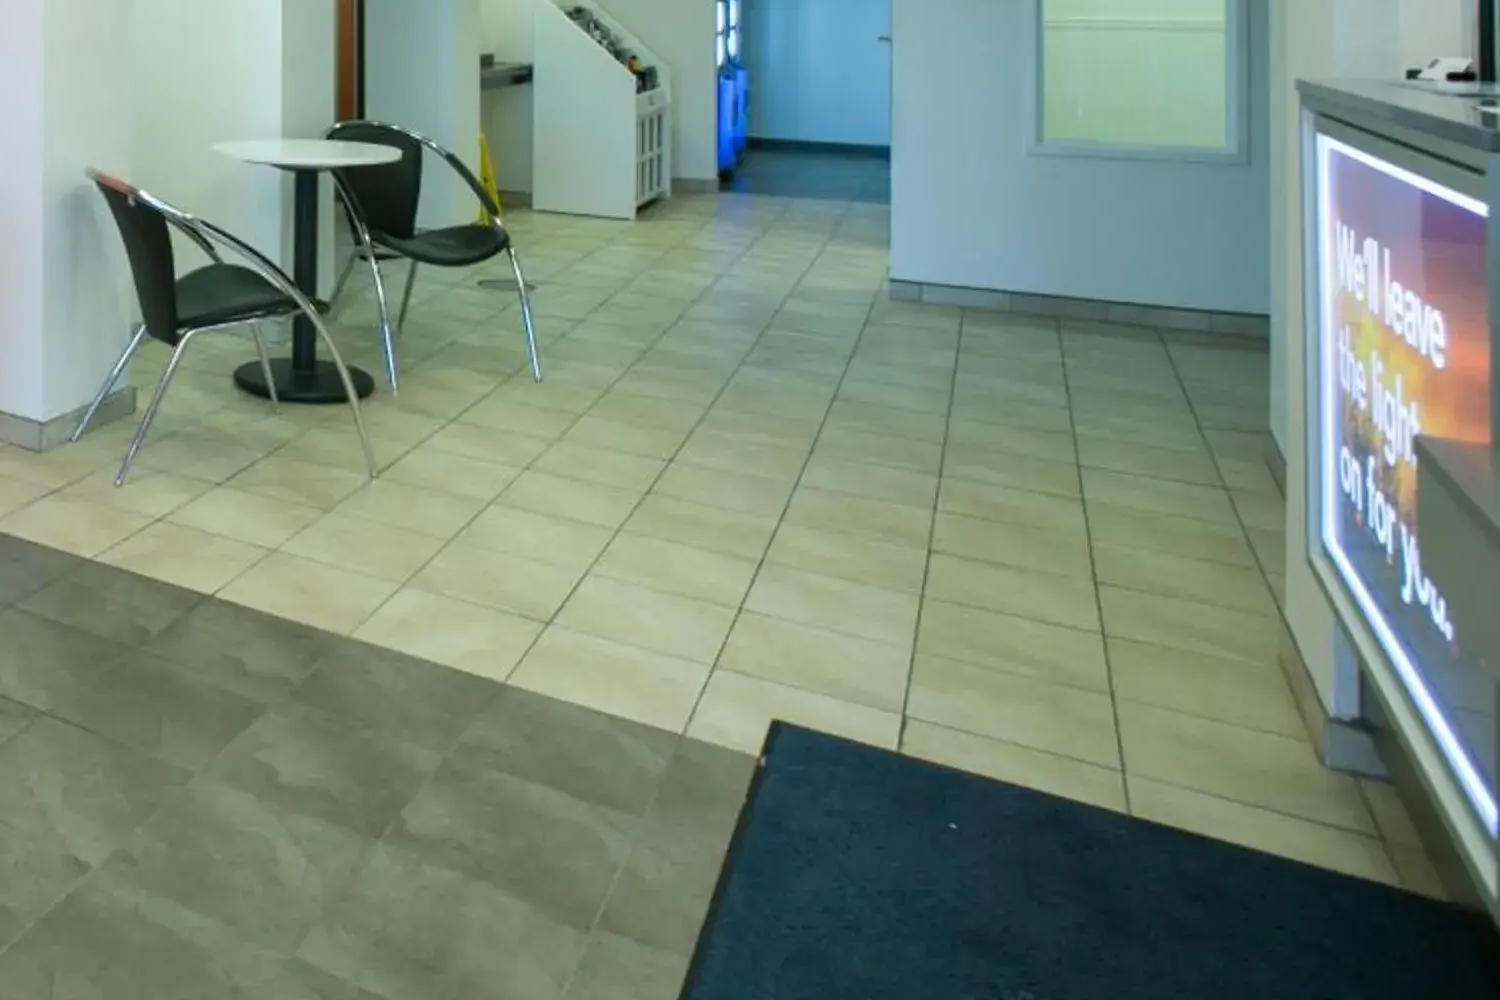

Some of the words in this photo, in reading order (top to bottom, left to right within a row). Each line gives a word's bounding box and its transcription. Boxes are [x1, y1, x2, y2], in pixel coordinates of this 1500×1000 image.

[1336, 220, 1380, 316] We'll
[1383, 247, 1446, 369] leave
[1338, 323, 1367, 410] the
[1370, 349, 1420, 470] light
[1340, 446, 1363, 512] on
[1366, 455, 1397, 556] for
